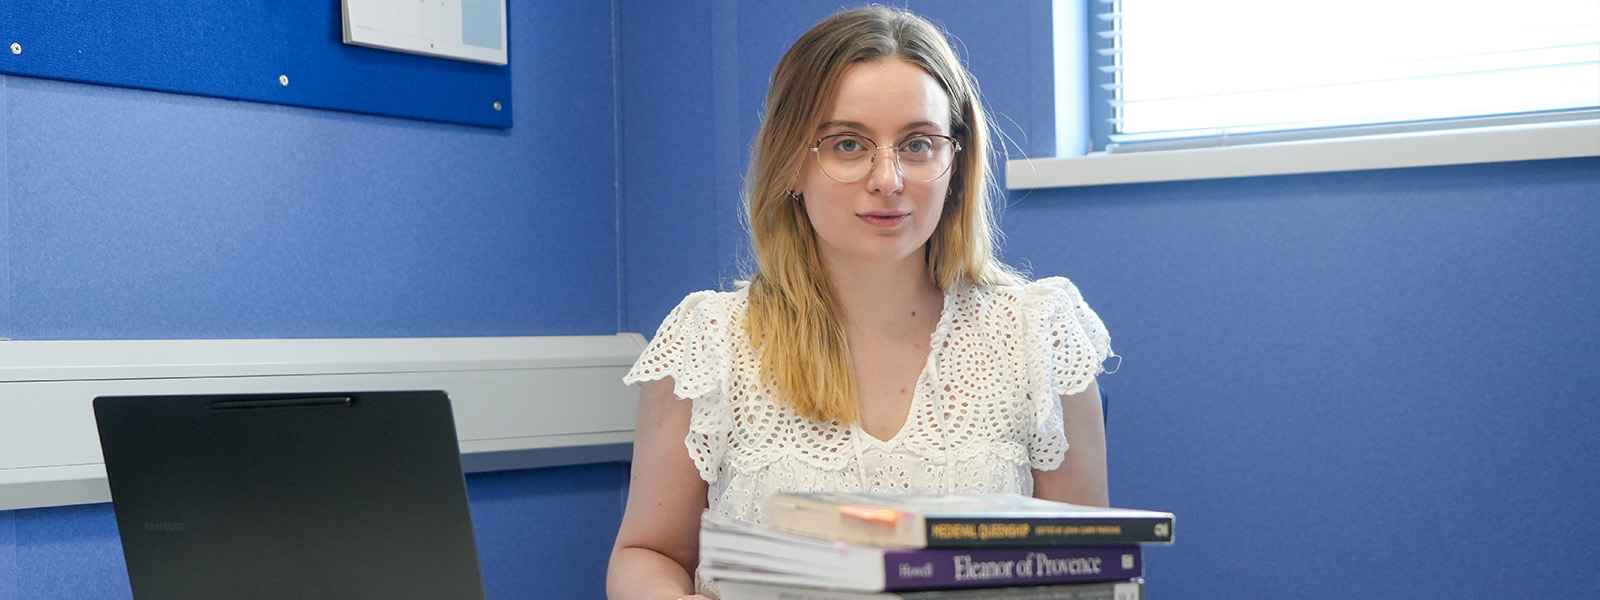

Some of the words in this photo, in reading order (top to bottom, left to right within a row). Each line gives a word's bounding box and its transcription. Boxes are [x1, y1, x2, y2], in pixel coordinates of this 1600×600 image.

[144, 522, 186, 531] SAMSUNG
[931, 523, 977, 539] MEDIEVAL
[977, 523, 1031, 540] QUEENSHIP
[953, 554, 1014, 581] Eleanor
[1015, 552, 1036, 579] of
[1036, 552, 1102, 578] Provence
